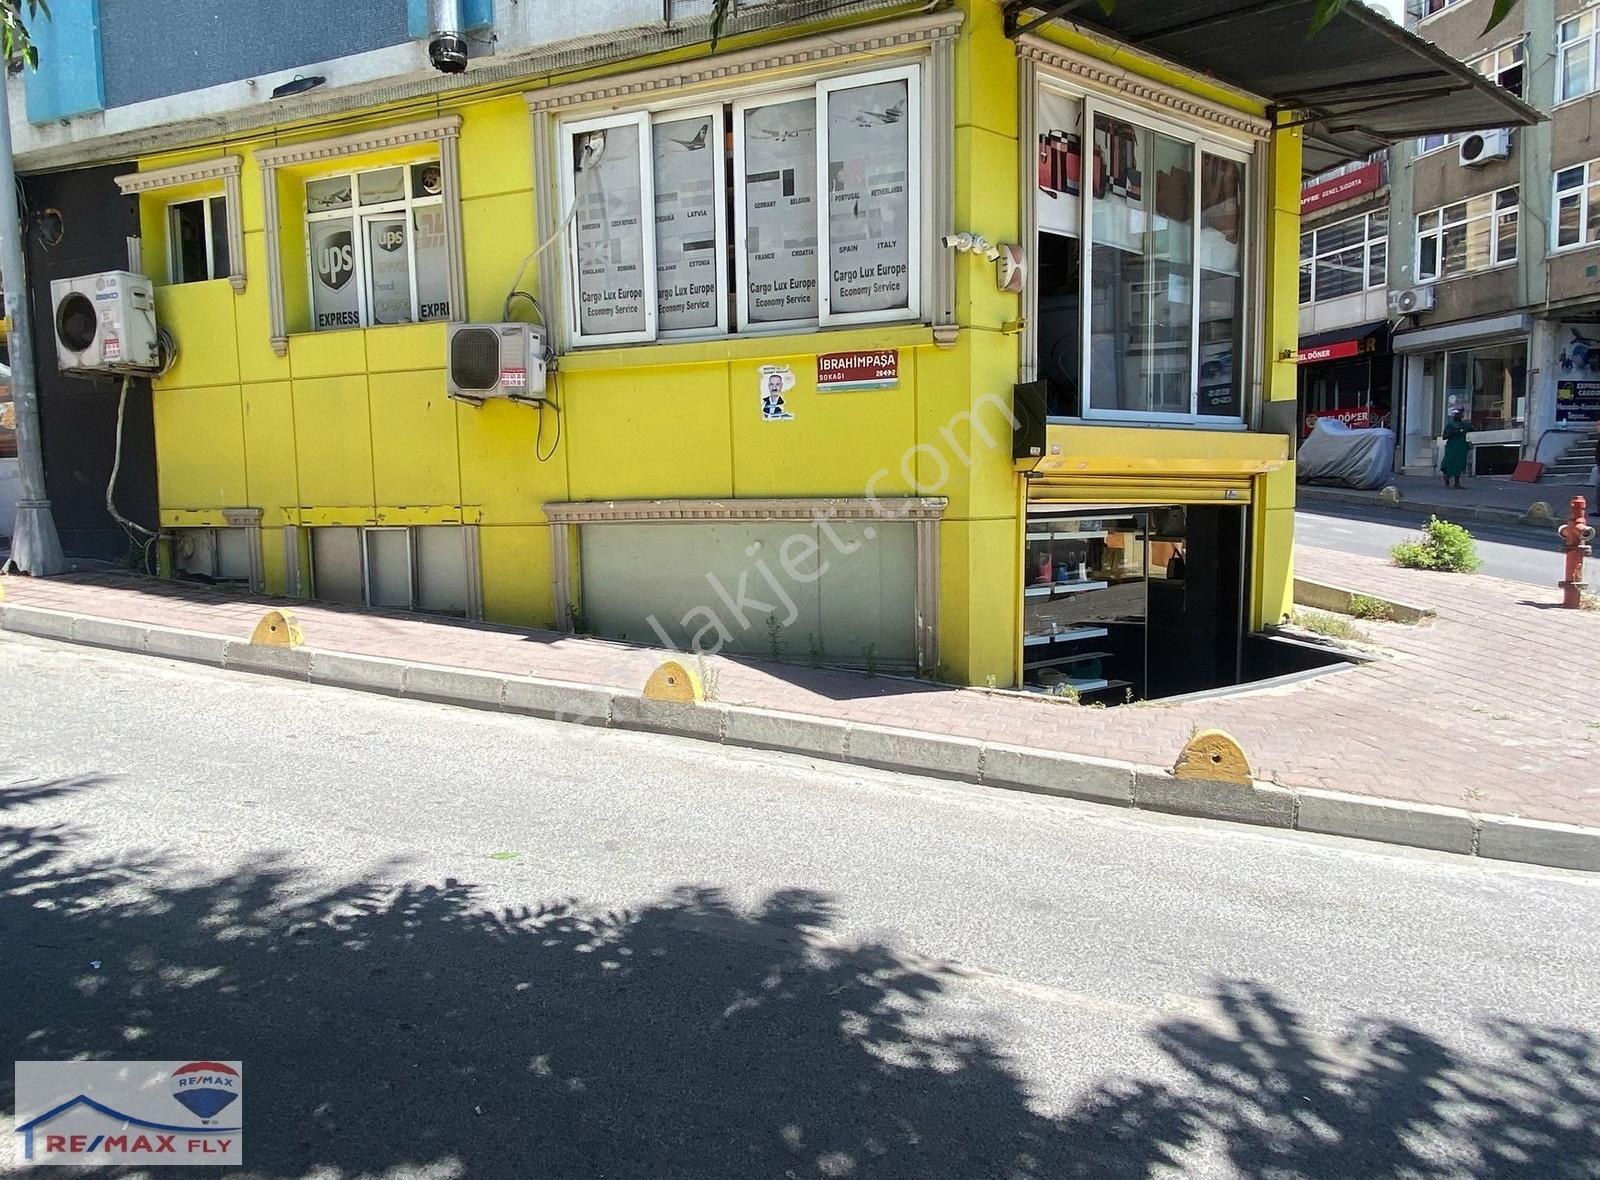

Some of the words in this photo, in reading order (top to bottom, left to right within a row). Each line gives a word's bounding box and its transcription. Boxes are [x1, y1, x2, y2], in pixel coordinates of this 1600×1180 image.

[835, 192, 860, 202] PORTUGAL
[871, 186, 903, 197] NETHERLANDS
[754, 201, 776, 209] GERMANY
[790, 197, 811, 205] BELGIUM
[687, 210, 707, 218] LATVIA
[839, 245, 858, 253] SPAIN
[877, 240, 897, 249] ITALY
[755, 253, 775, 261] FRANCE
[791, 249, 814, 257] CROATIA
[689, 259, 710, 267] ESTONIA
[582, 268, 605, 276] ENGLAND
[834, 270, 858, 283] Cargo
[860, 266, 875, 278] Lux
[877, 264, 906, 277] Europe
[657, 288, 673, 301] argo
[675, 285, 687, 296] Lux
[689, 283, 714, 296] Europe
[750, 282, 772, 295] Cargo
[774, 281, 788, 291] Lux
[790, 279, 816, 290] Europe
[840, 286, 871, 297] Economy
[873, 281, 900, 293] Service
[582, 291, 602, 304] Cargo
[604, 290, 616, 300] Lux
[618, 288, 642, 301] Europe
[756, 297, 785, 308] Economy
[786, 294, 810, 304] Service
[587, 307, 614, 317] Economy
[615, 304, 637, 314] Service
[658, 303, 685, 313] Economy
[686, 300, 709, 311] Service
[319, 311, 359, 327] EXPRESS
[1307, 349, 1331, 360] DÖNER
[820, 354, 895, 370] İBRAHİMPAŞA
[819, 373, 845, 381] SOKAĞI
